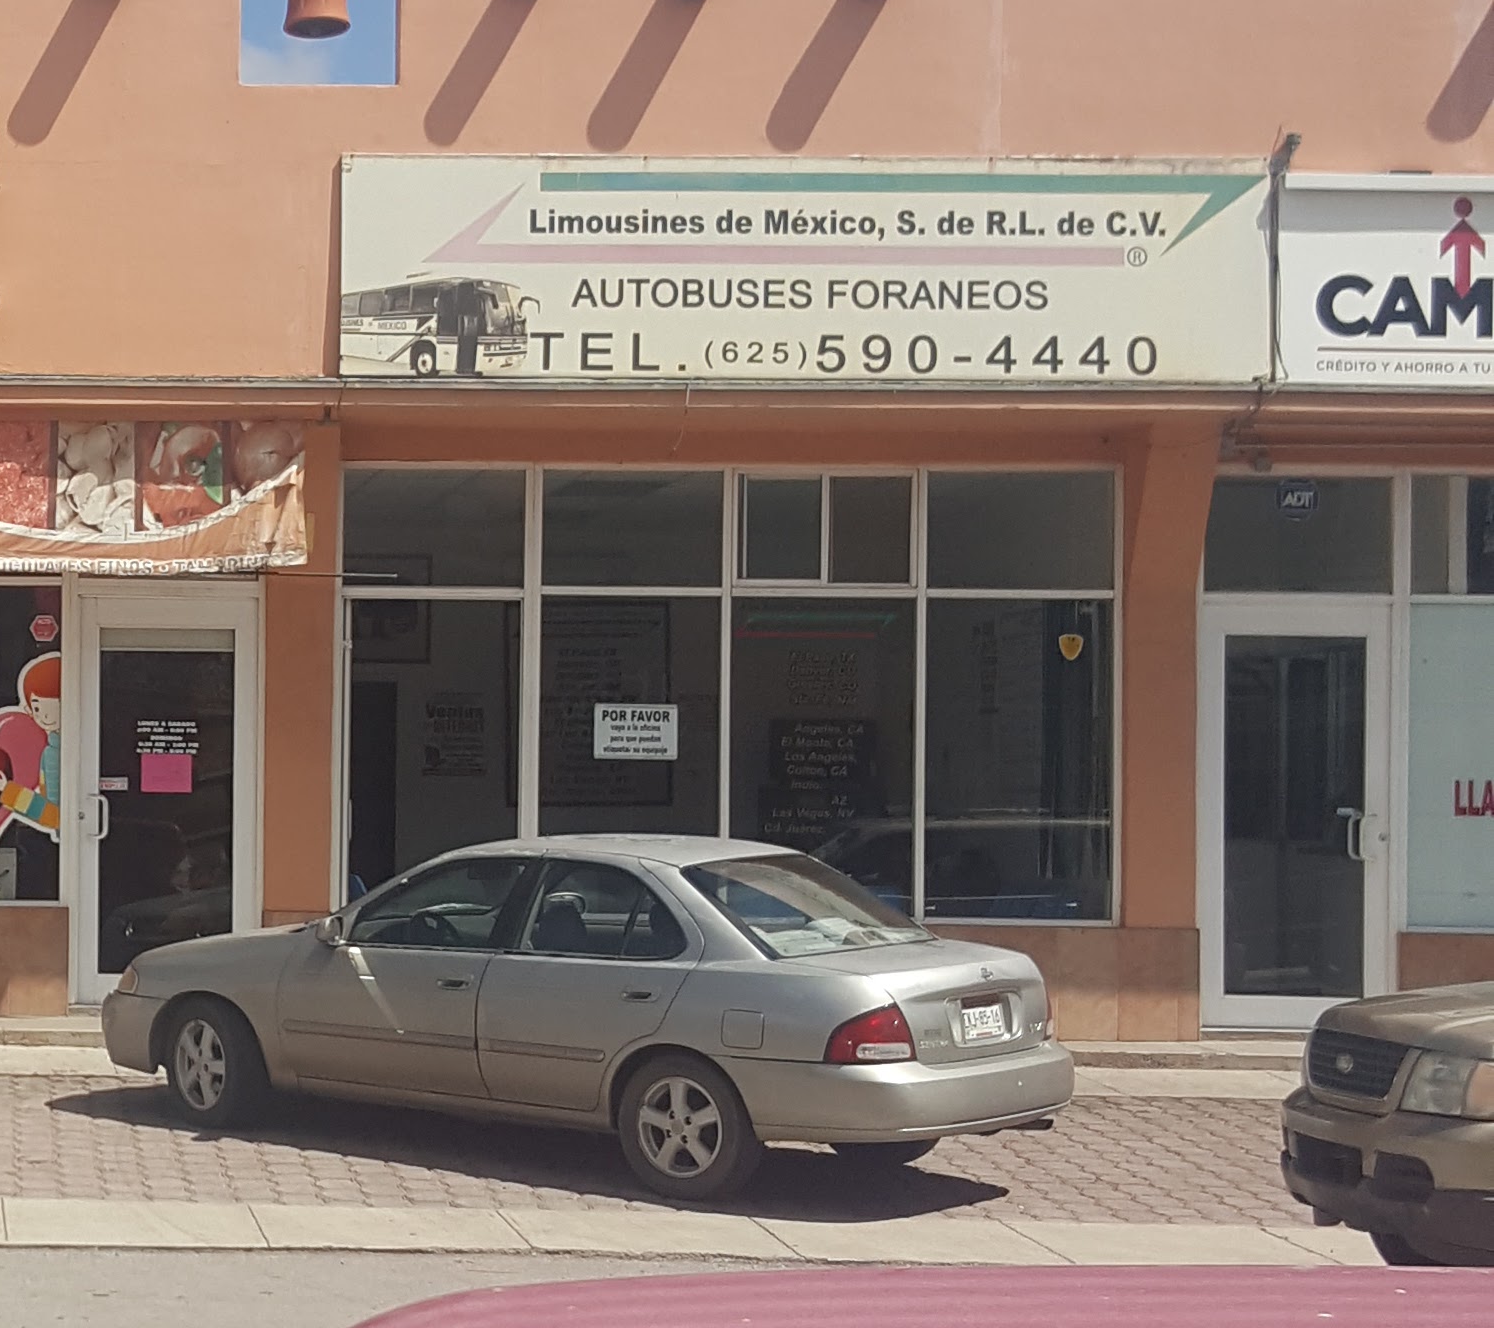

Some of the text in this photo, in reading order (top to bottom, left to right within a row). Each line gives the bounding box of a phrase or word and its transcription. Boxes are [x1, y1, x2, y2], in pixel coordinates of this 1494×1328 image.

[529, 208, 1166, 240] Limousines de México, S. de R.L. de C.V.
[571, 277, 1049, 311] AUTOBUSES FORANEOS
[529, 332, 686, 372] TEL.
[1316, 359, 1491, 374] CRÉDITO Y AHORRO A TU
[1281, 490, 1314, 509] ADT
[601, 709, 670, 723] POR FAVOR
